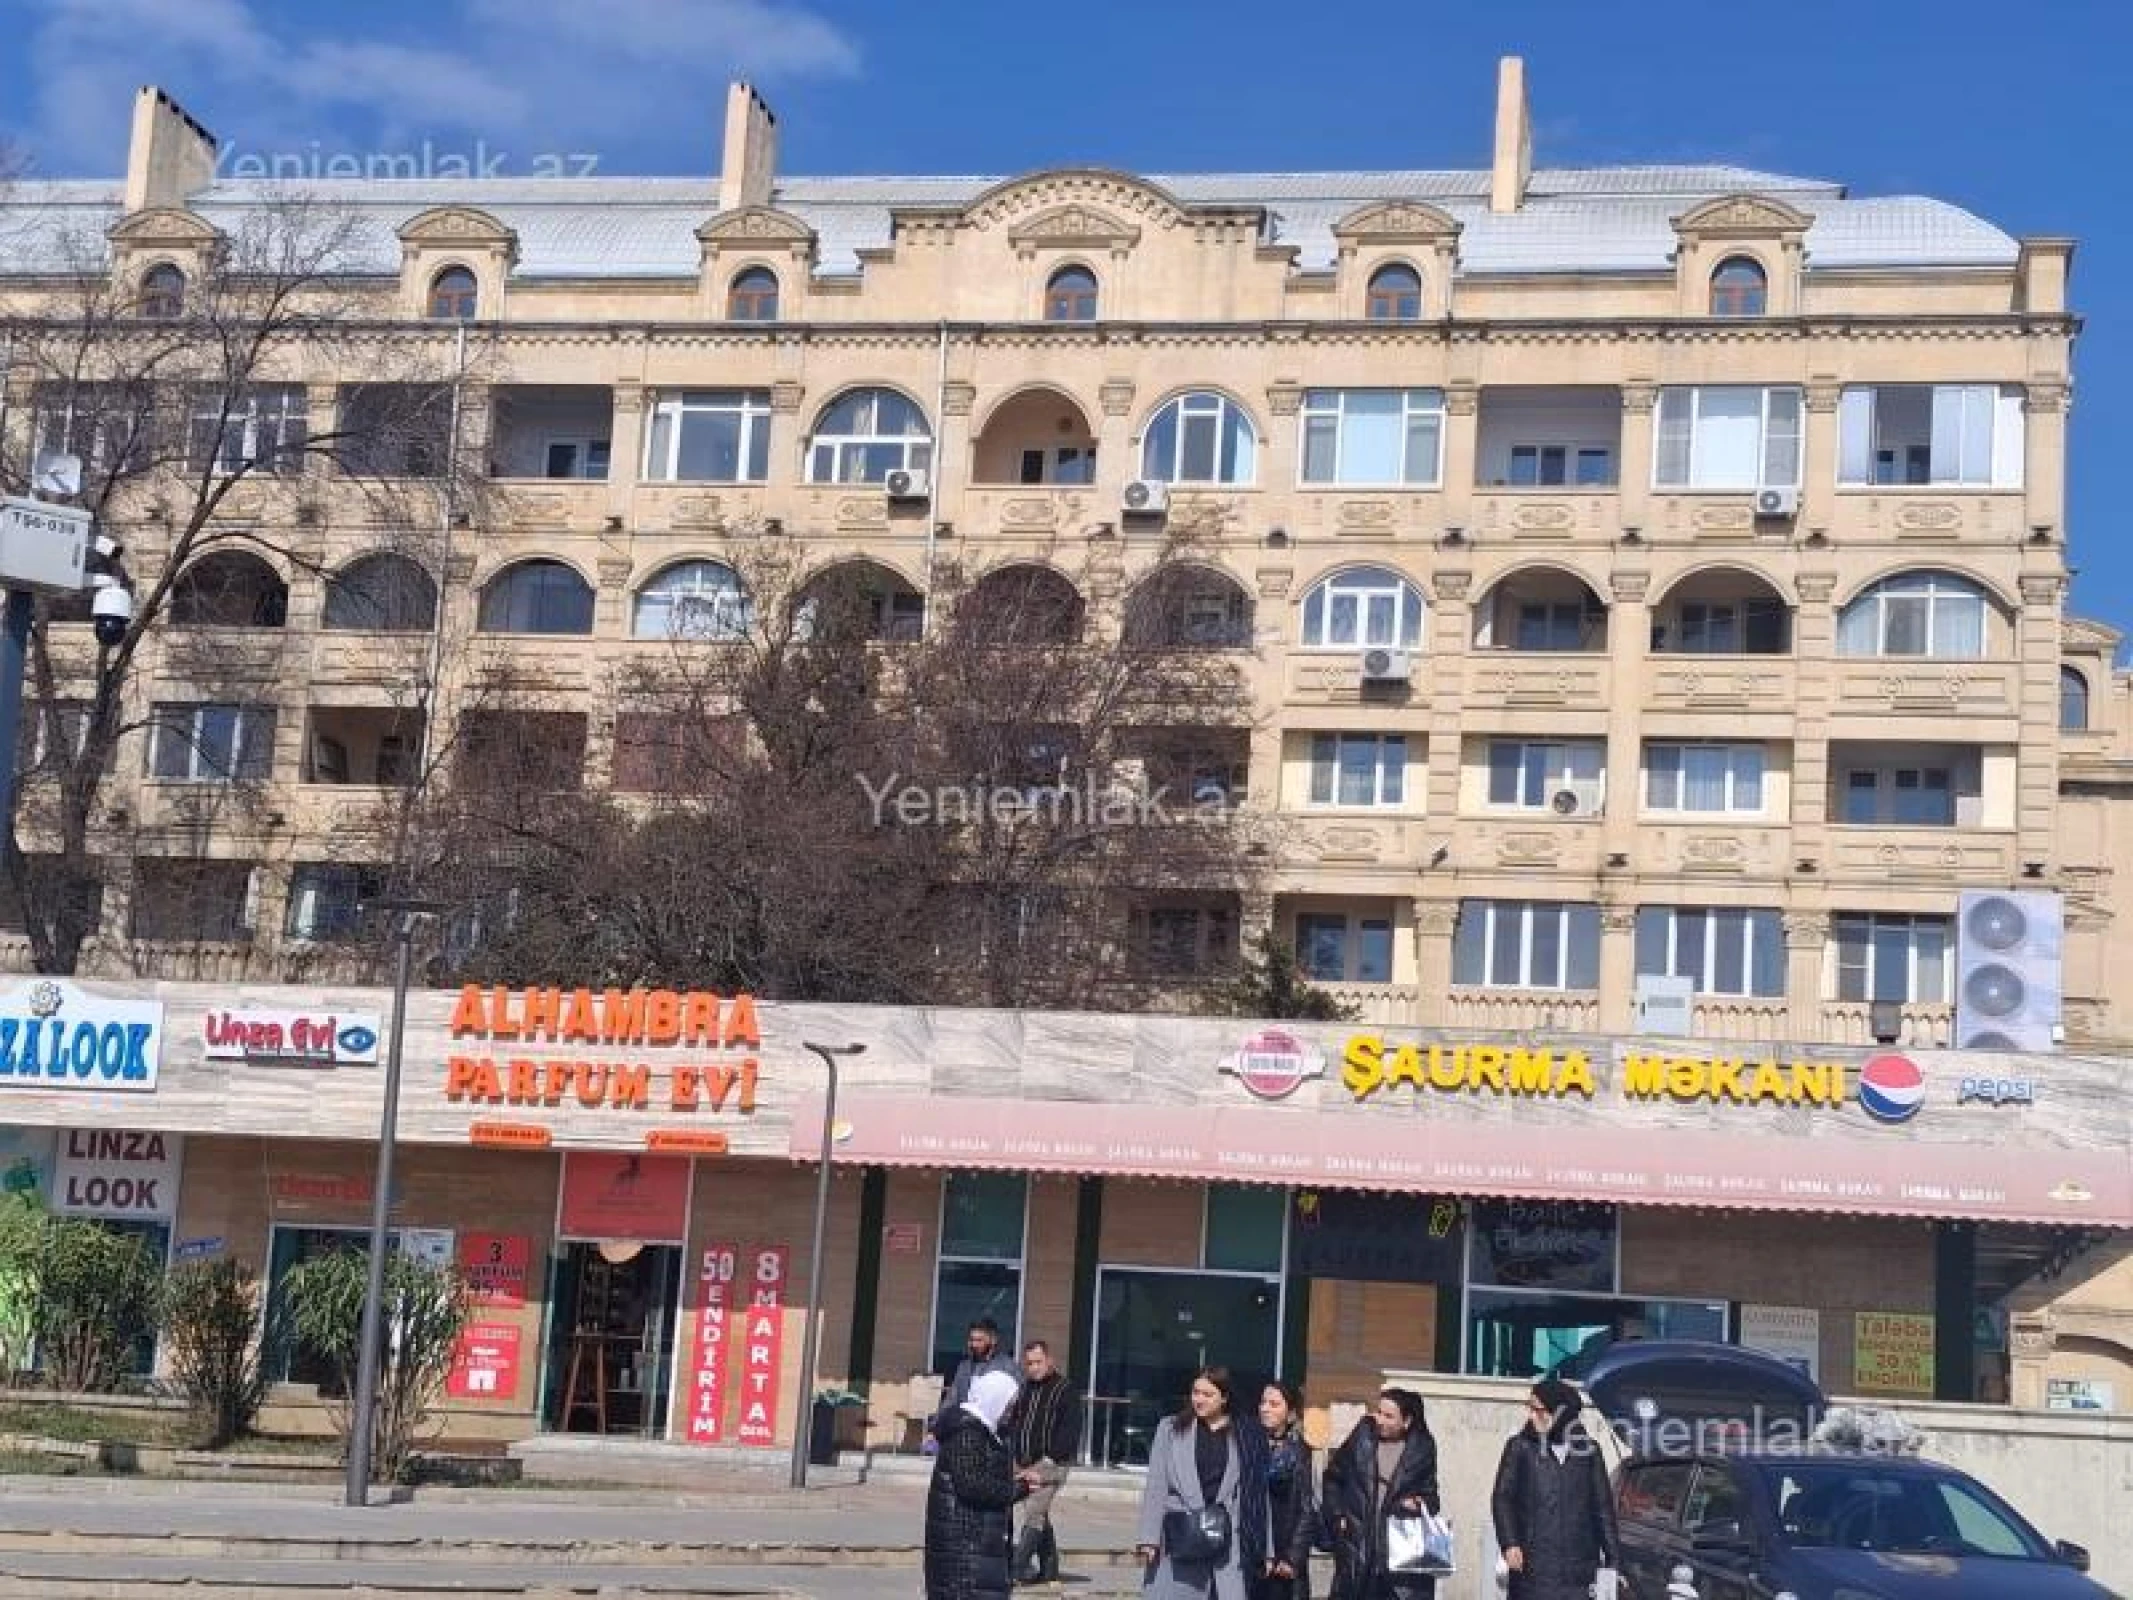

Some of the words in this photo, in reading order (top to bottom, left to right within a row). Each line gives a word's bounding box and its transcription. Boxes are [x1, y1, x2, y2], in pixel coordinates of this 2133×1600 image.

[451, 984, 761, 1048] ALHAMBRA
[47, 1021, 152, 1081] LOOK
[1343, 1034, 1594, 1103] ŞAURMA
[1624, 1053, 1848, 1108] MƏKANI
[447, 1056, 650, 1109] PARFUM
[672, 1058, 759, 1112] EVİ
[1958, 1076, 2034, 1106] pepsi
[67, 1131, 166, 1162] LINZA
[65, 1176, 158, 1209] LOOK
[701, 1252, 735, 1281] 50
[756, 1252, 780, 1281] 8
[748, 1289, 777, 1422] MARTA
